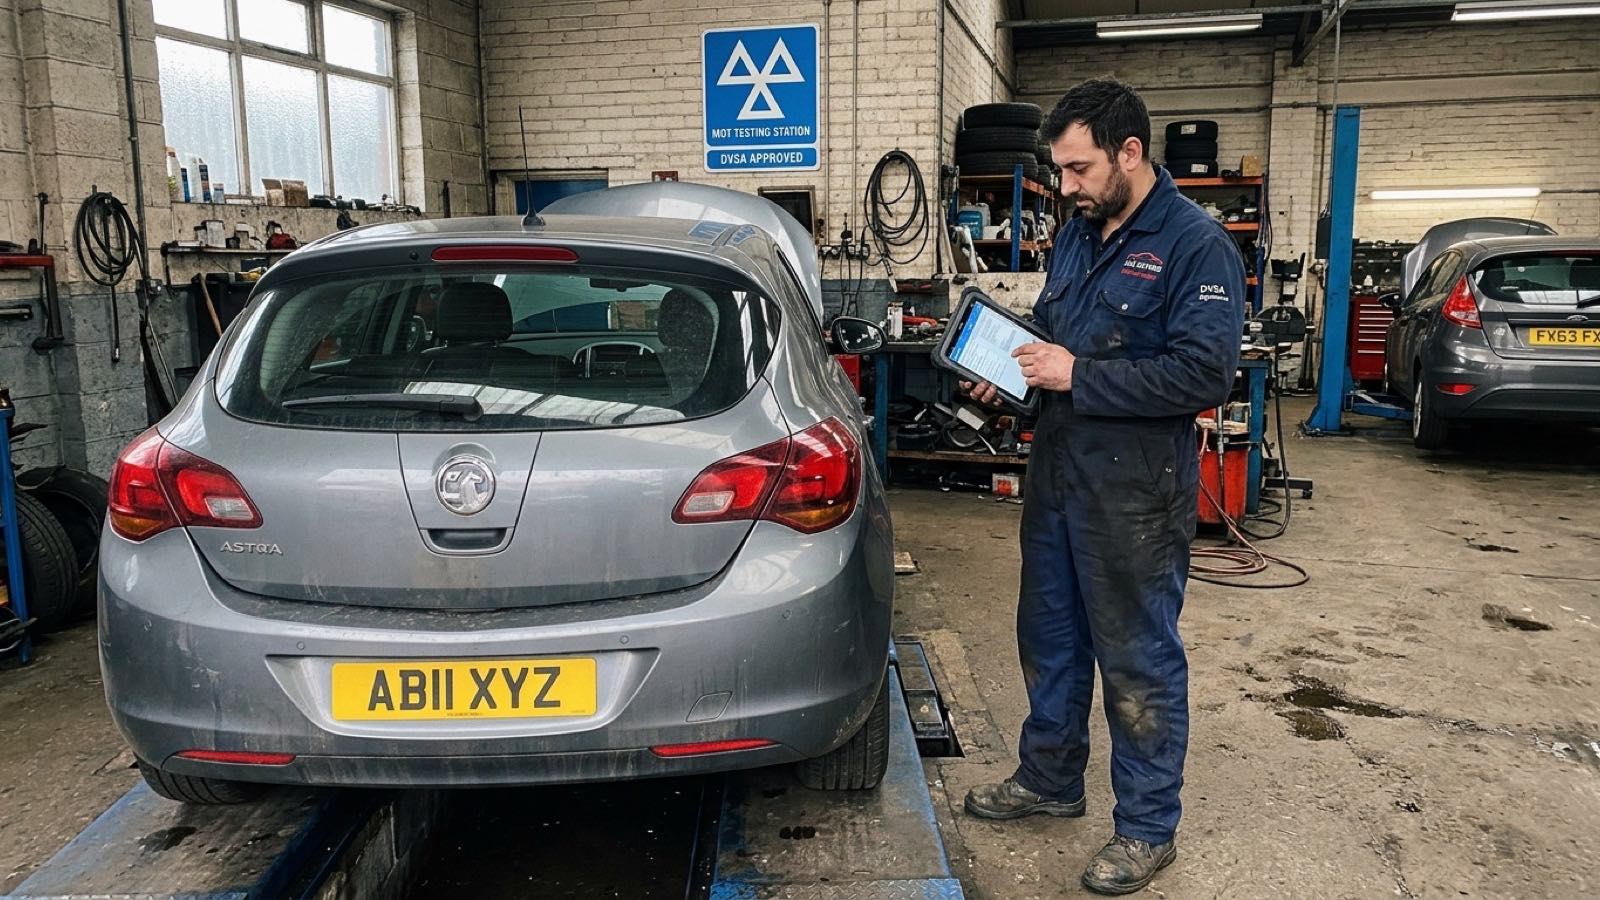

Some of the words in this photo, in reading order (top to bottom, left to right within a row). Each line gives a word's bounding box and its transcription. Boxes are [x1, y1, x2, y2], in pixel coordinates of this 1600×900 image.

[712, 128, 731, 138] MOT
[734, 127, 771, 138] TESTING
[773, 126, 810, 136] STATION
[721, 153, 747, 164] DVSA
[749, 152, 803, 164] APPROVED
[1200, 284, 1225, 295] DVSA
[1537, 330, 1577, 343] FX63
[469, 666, 561, 709] XYZ
